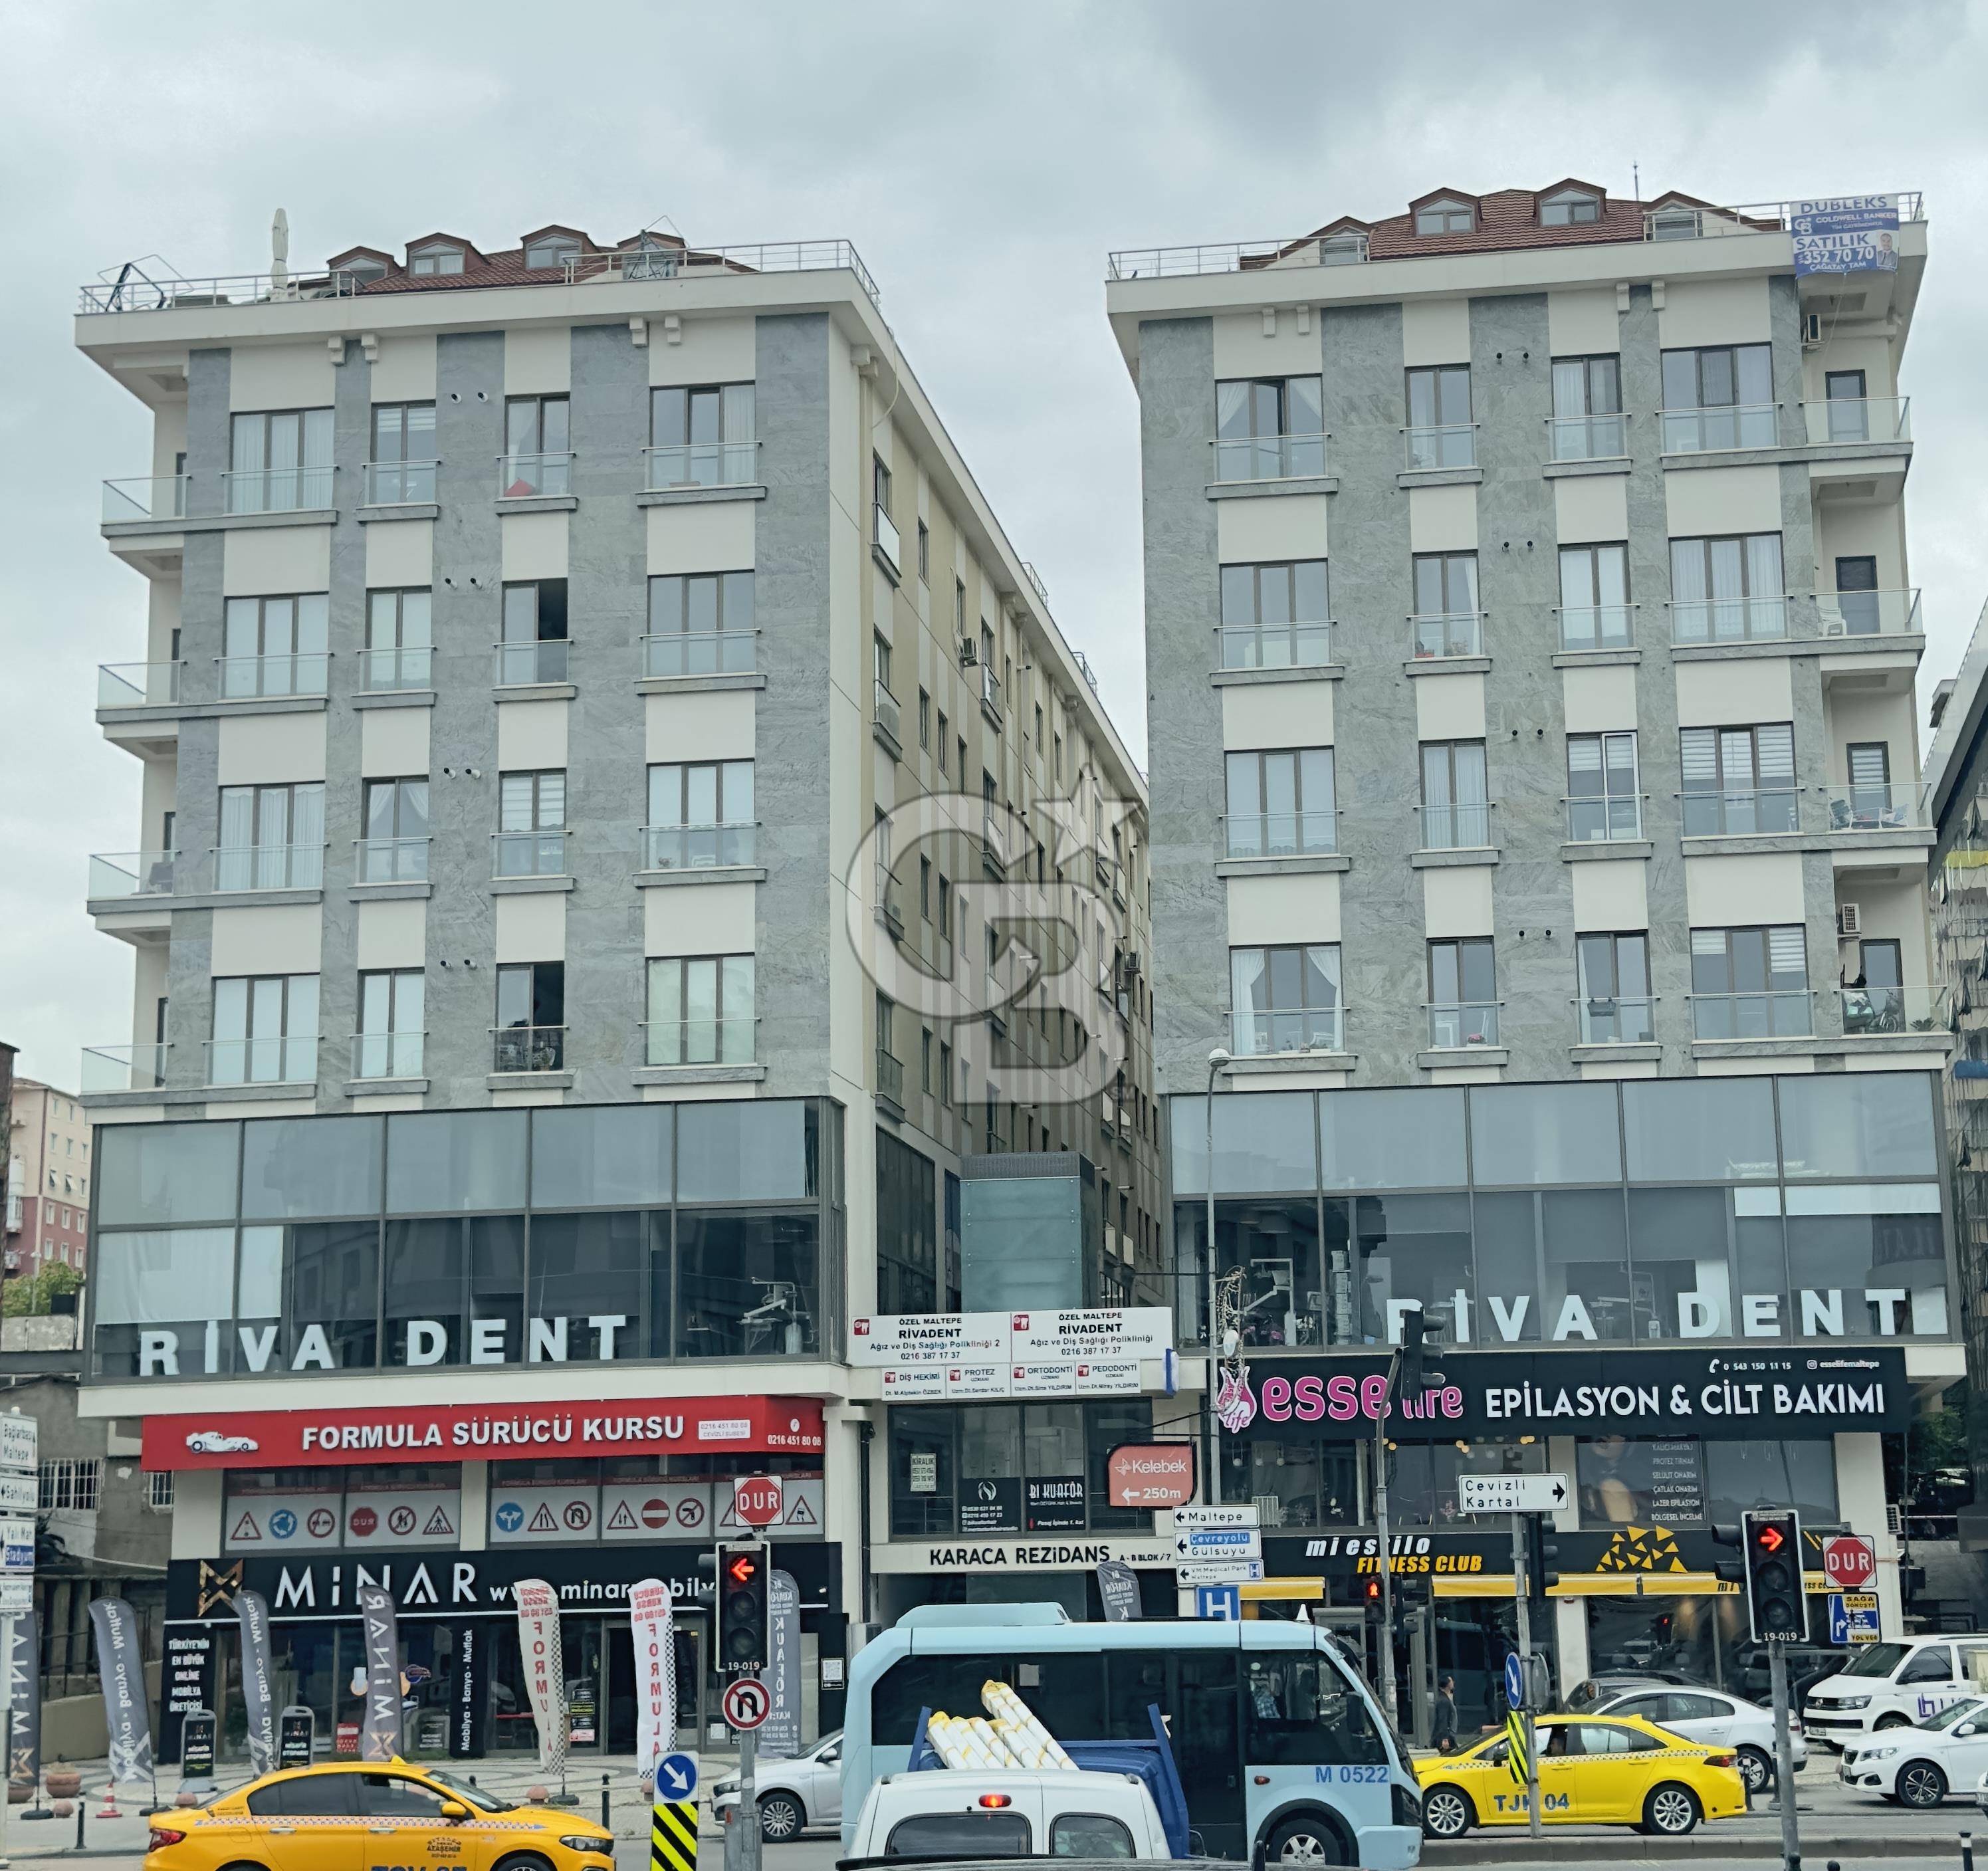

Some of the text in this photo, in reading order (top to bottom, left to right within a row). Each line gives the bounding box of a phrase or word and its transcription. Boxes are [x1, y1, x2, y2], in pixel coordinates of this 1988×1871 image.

[1801, 197, 1887, 214] DUBLEKS
[1816, 214, 1862, 223] COLDWELL
[1796, 233, 1870, 251] SATILIK
[1804, 250, 1830, 265] 352
[1834, 249, 1852, 263] 70
[1856, 247, 1874, 261] 70
[1678, 1288, 1906, 1339] DENT
[899, 1328, 962, 1339] RİVADENT
[1059, 1323, 1123, 1335] RİVADENT
[140, 1315, 626, 1376] RİVA DENT
[919, 1341, 948, 1350] Sağlığı
[950, 1340, 992, 1349] Polikliniği
[1030, 1339, 1048, 1347] Ağız
[1079, 1337, 1108, 1345] Sağlığı
[1111, 1335, 1153, 1344] Polikliniği
[899, 1373, 912, 1382] DİŞ
[1262, 1375, 1392, 1421] esse
[1486, 1379, 1885, 1418] EPİLASYON & CİLT BAKIMI
[302, 1412, 684, 1451] FORMULA SÜRÜCÜ KURSU
[767, 1434, 786, 1445] 0216
[787, 1434, 800, 1446] 451
[802, 1435, 811, 1446] 80
[1133, 1459, 1187, 1474] Kelebek
[1042, 1481, 1083, 1499] KUAFÖR
[1466, 1480, 1526, 1491] Cevizli
[1653, 1486, 1674, 1495] ÇATLAK
[739, 1491, 778, 1511] DUR
[1466, 1496, 1521, 1507] Kartal
[1188, 1512, 1243, 1523] Maltepe
[1190, 1533, 1248, 1545] Çevreyolu
[1345, 1535, 1430, 1556] esilo
[930, 1545, 1110, 1565] KARACA REZİDANS
[1192, 1547, 1246, 1556] Gülsuyu
[1435, 1555, 1482, 1572] CLUB
[1828, 1553, 1870, 1571] DUR
[275, 1562, 479, 1609] MİNAR
[1763, 1632, 1797, 1642] 19-019
[728, 1662, 760, 1671] 19-019
[461, 1629, 474, 1751] Mobilya Banyo Mutfak
[1315, 1766, 1389, 1784] M 0522
[1544, 1793, 1570, 1811] 04
